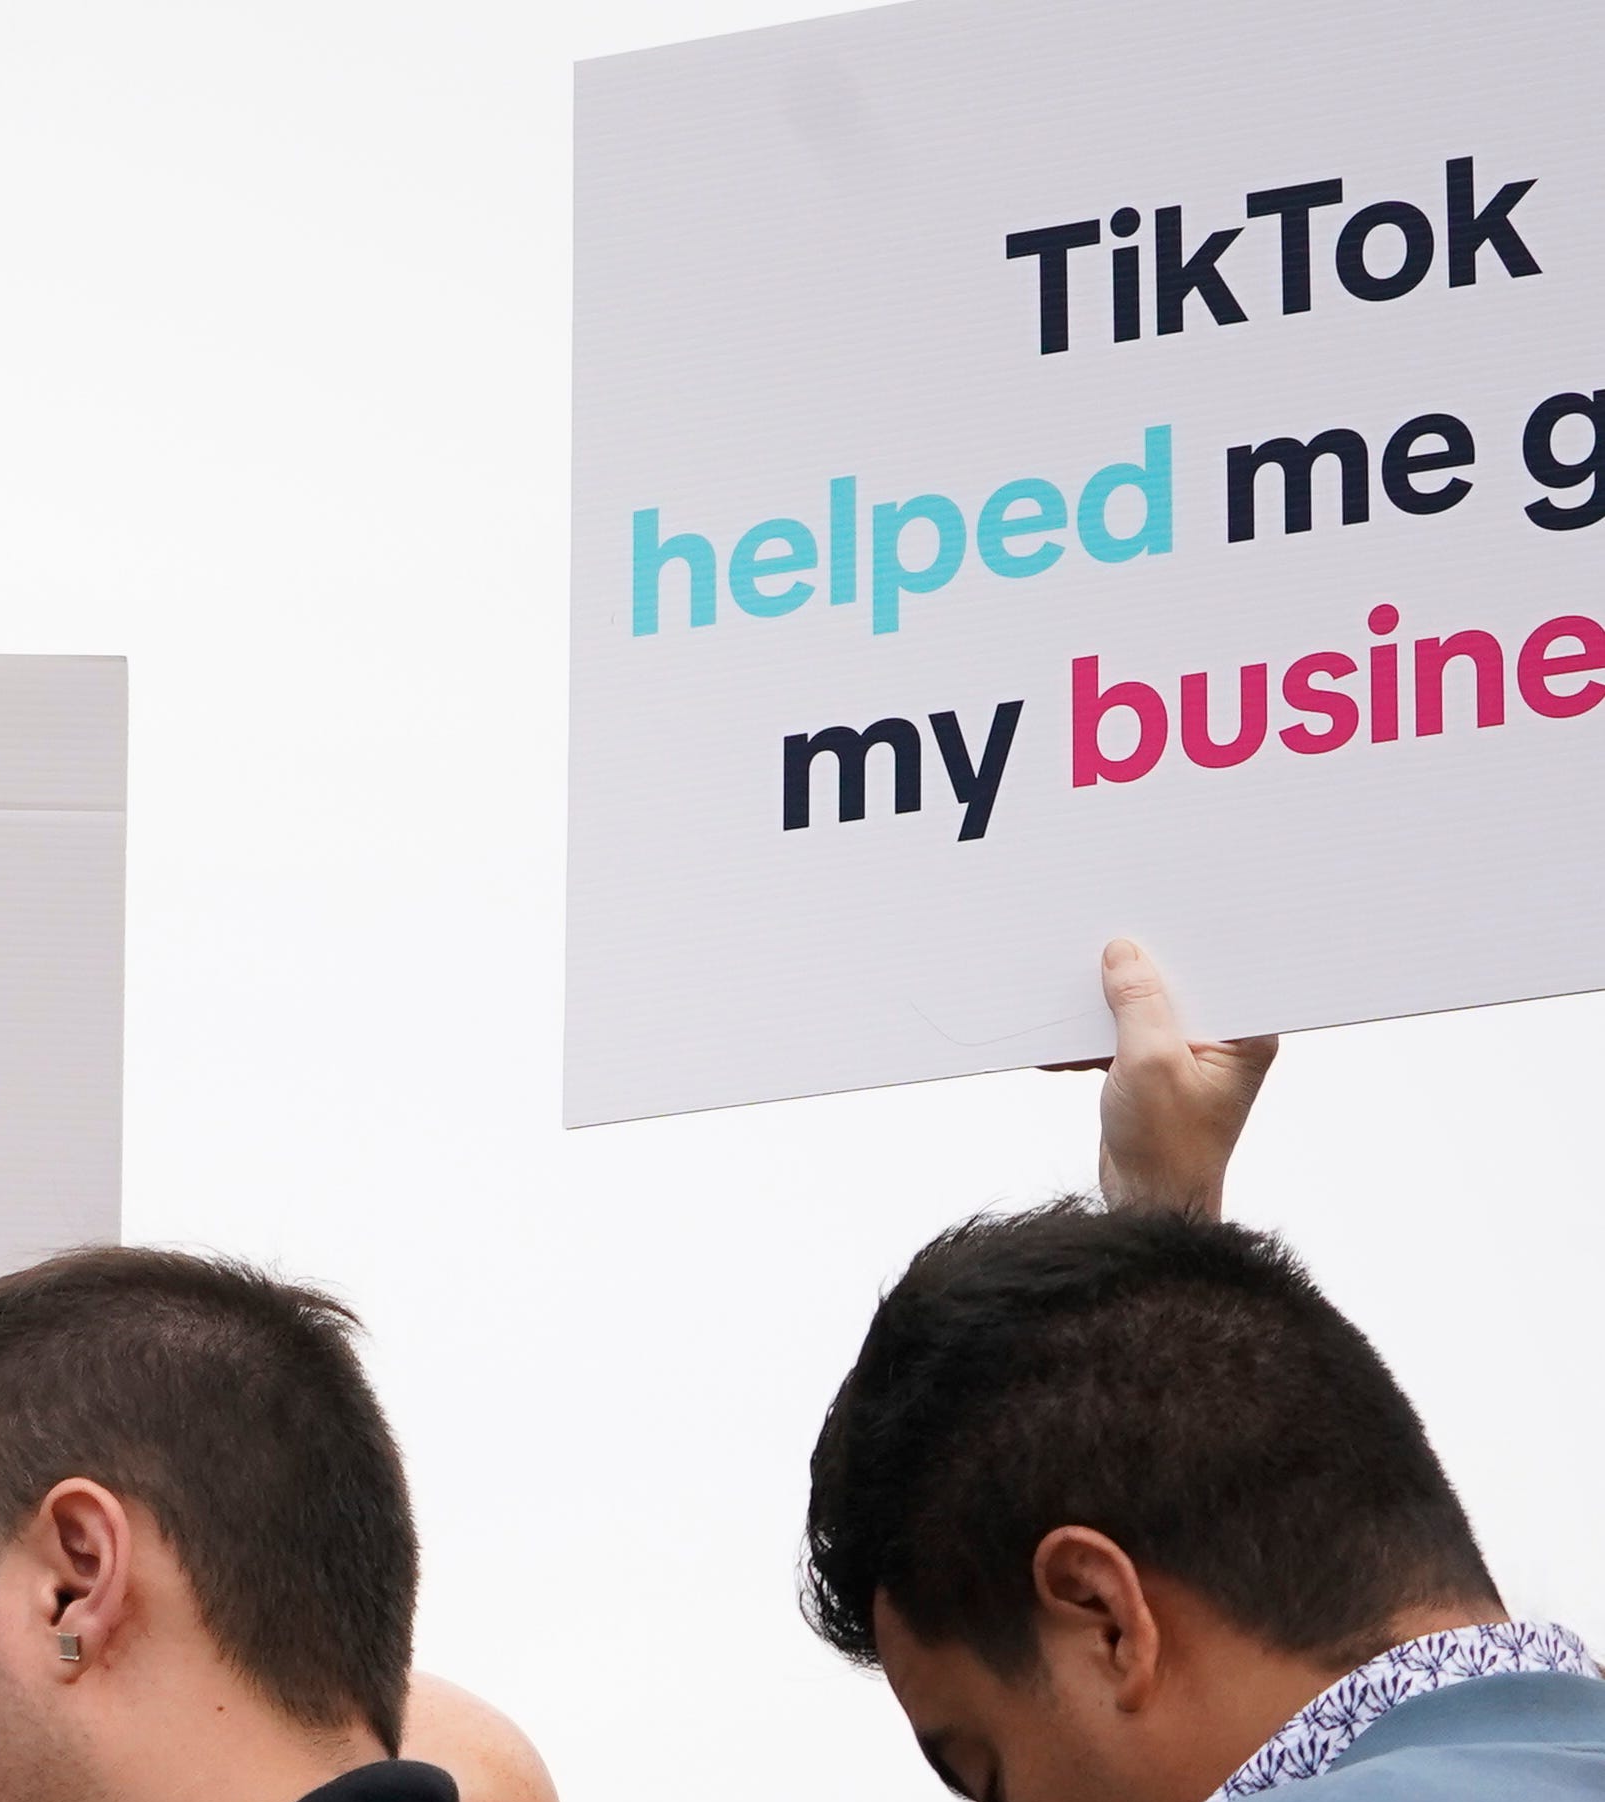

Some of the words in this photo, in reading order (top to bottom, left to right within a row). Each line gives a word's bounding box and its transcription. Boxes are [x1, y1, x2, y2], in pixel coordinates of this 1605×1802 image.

[1006, 156, 1543, 355] TikTok
[633, 424, 1173, 637] helped
[1227, 413, 1475, 543] me
[783, 699, 1025, 842] my
[1072, 604, 1605, 788] busine
